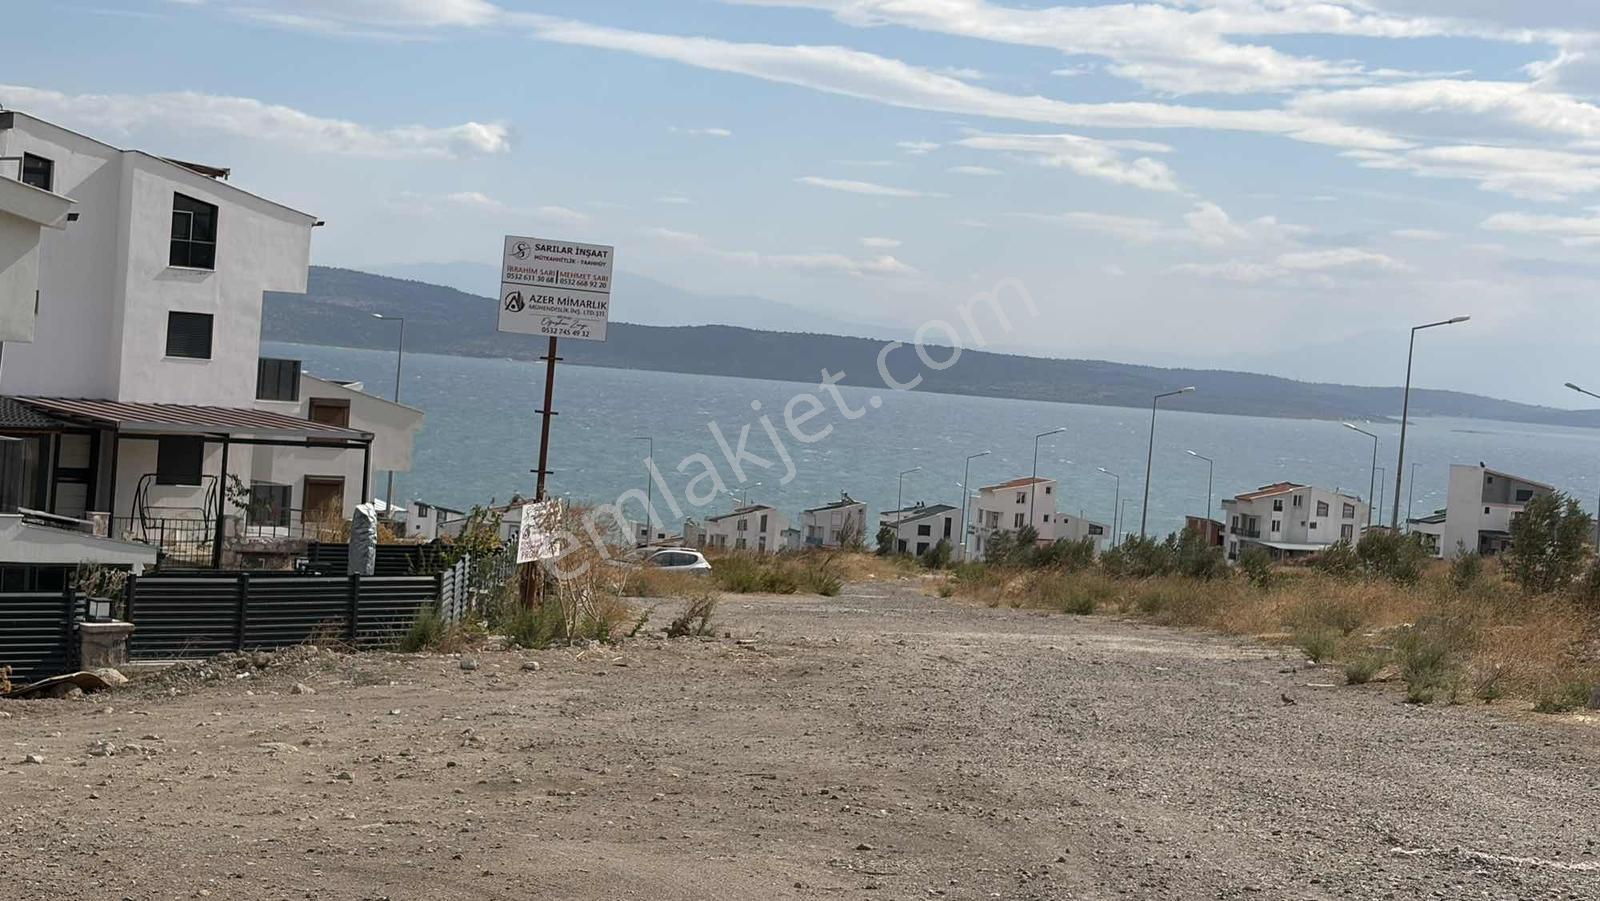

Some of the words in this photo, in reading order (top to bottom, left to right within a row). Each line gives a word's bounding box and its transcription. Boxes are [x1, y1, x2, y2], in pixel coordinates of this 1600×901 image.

[534, 243, 573, 254] SARILAR
[575, 245, 608, 258] İNŞAAT
[507, 265, 539, 274] İBRAHİM
[540, 268, 555, 276] SARI
[507, 272, 523, 280] 0532
[560, 271, 591, 280] MEHMET
[593, 274, 608, 282] SARI
[560, 277, 576, 286] 0532
[590, 280, 598, 288] 92
[529, 294, 555, 305] AZER
[557, 296, 607, 310] MİMARLIK
[528, 304, 568, 313] MÜHENDİSLİK
[541, 326, 558, 334] 0532
